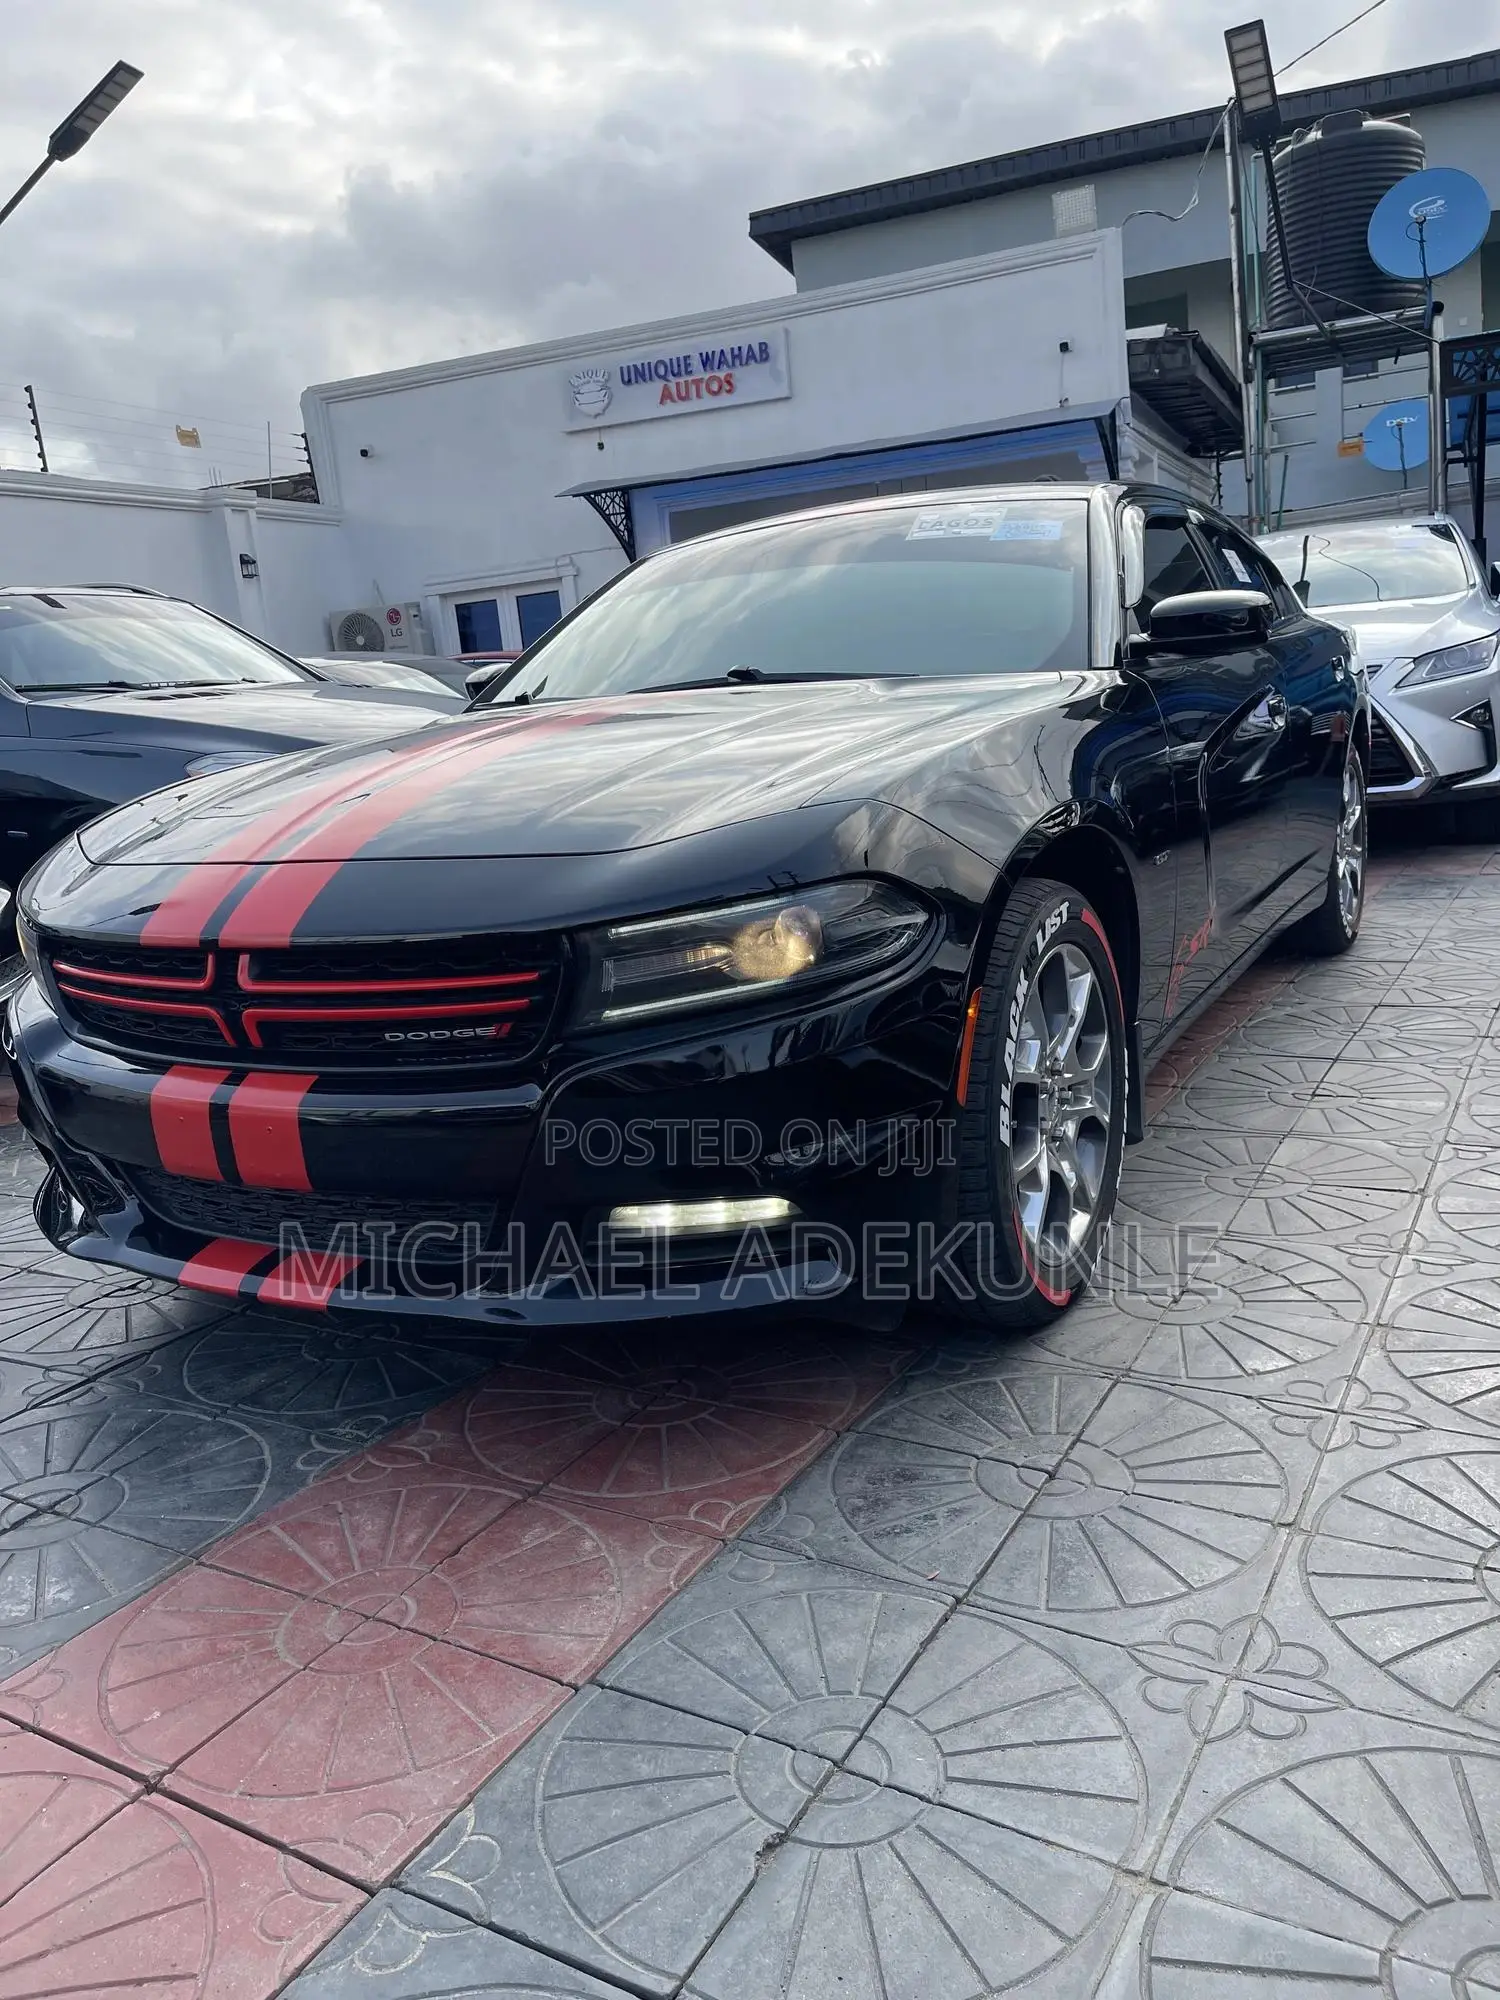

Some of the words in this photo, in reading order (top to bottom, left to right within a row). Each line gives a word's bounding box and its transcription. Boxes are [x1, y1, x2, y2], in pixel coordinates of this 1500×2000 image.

[620, 355, 693, 386] UNIQUE
[699, 341, 770, 373] WAHAB
[658, 372, 735, 406] AUTOS
[390, 628, 403, 637] LG
[384, 1026, 497, 1041] DODGE
